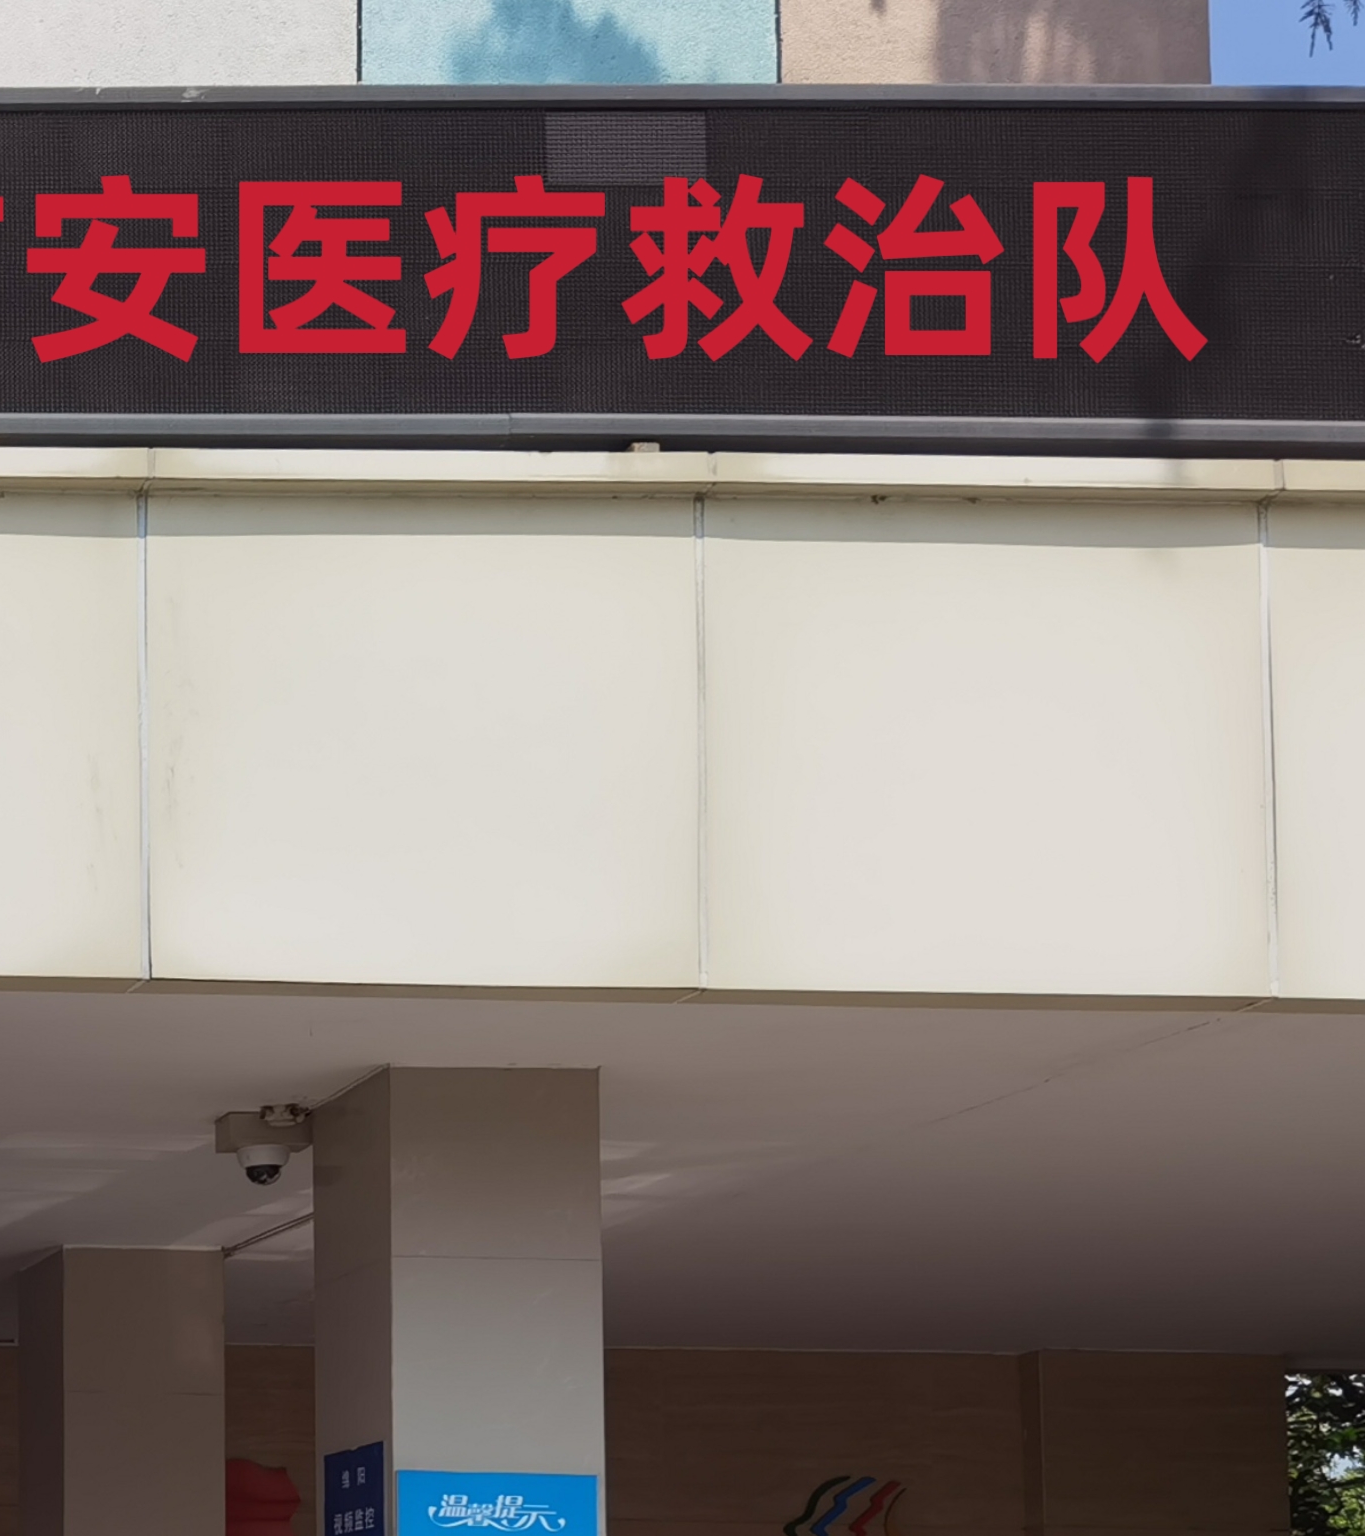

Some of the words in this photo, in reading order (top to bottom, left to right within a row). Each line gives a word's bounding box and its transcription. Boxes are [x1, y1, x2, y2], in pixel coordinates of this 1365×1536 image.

[334, 1507, 375, 1535] 视频监控
[428, 1494, 566, 1532] 温馨提示
